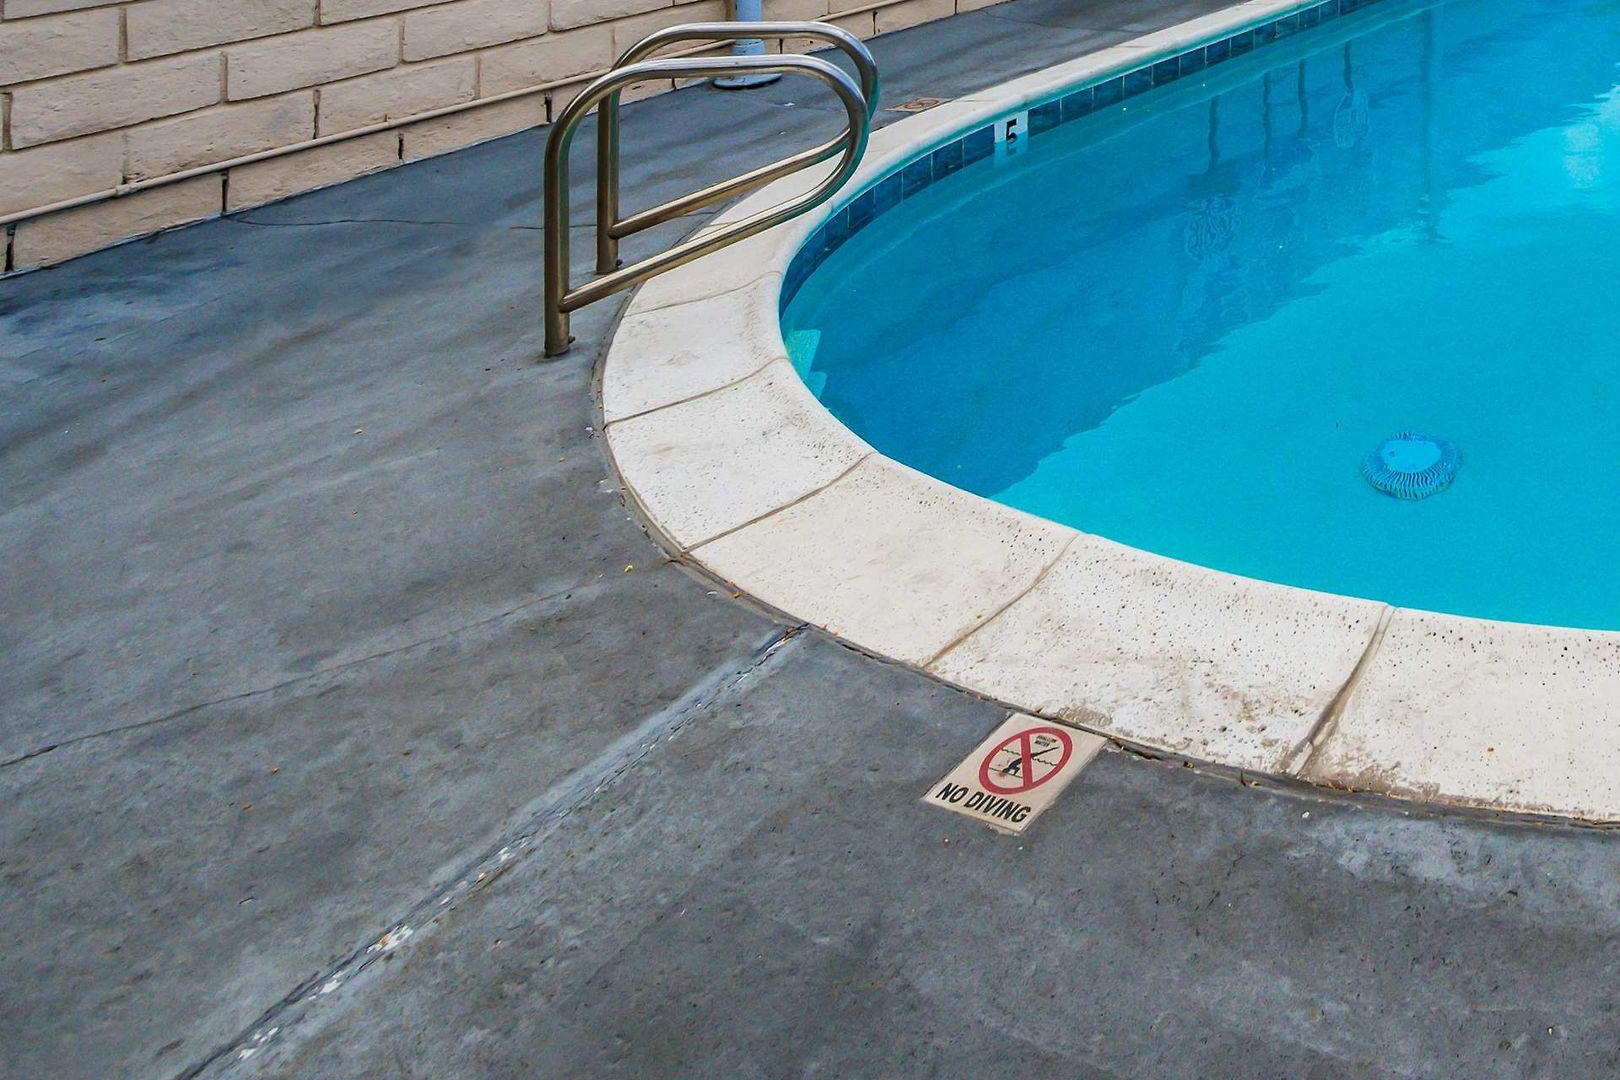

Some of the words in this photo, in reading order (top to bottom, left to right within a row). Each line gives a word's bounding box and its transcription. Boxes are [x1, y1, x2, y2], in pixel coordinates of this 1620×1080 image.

[1006, 118, 1017, 145] 5
[935, 782, 969, 803] NO
[964, 791, 1032, 824] DIVING
